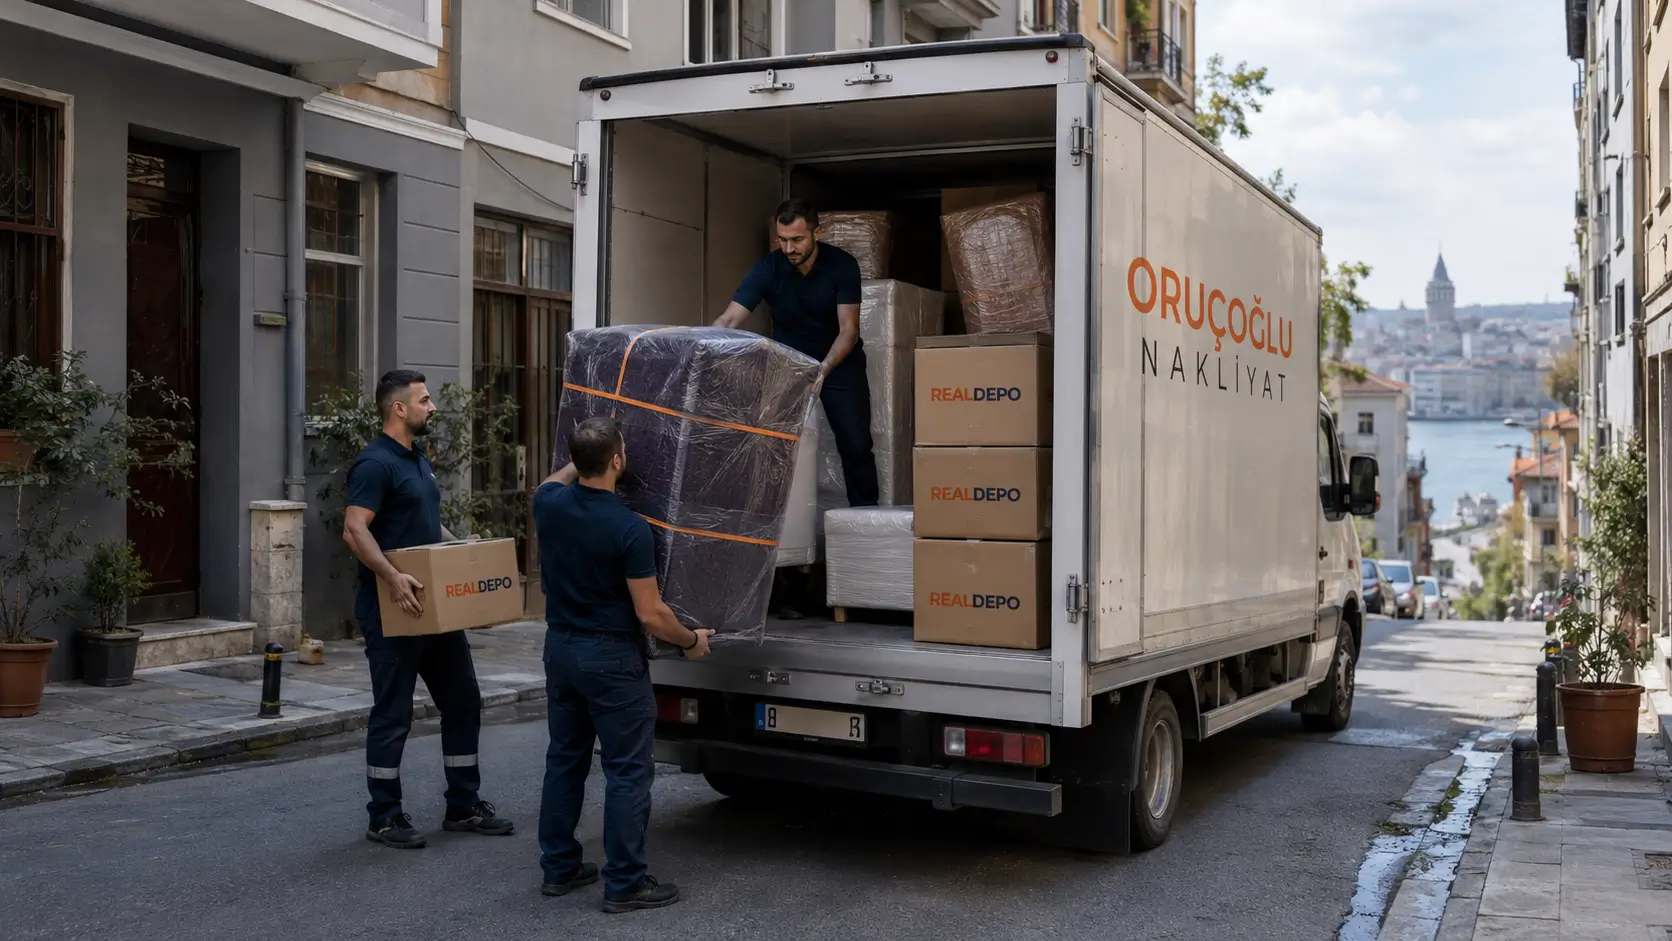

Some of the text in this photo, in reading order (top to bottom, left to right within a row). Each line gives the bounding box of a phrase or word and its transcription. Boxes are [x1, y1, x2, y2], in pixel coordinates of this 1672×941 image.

[1127, 256, 1292, 358] ORUÇOĞLU
[1141, 336, 1286, 402] NAKLİYAT
[930, 386, 1022, 402] REALDEPO
[930, 486, 1022, 502] REALDEPO
[445, 576, 512, 598] REALDEPO
[929, 591, 1021, 611] REALDEPO
